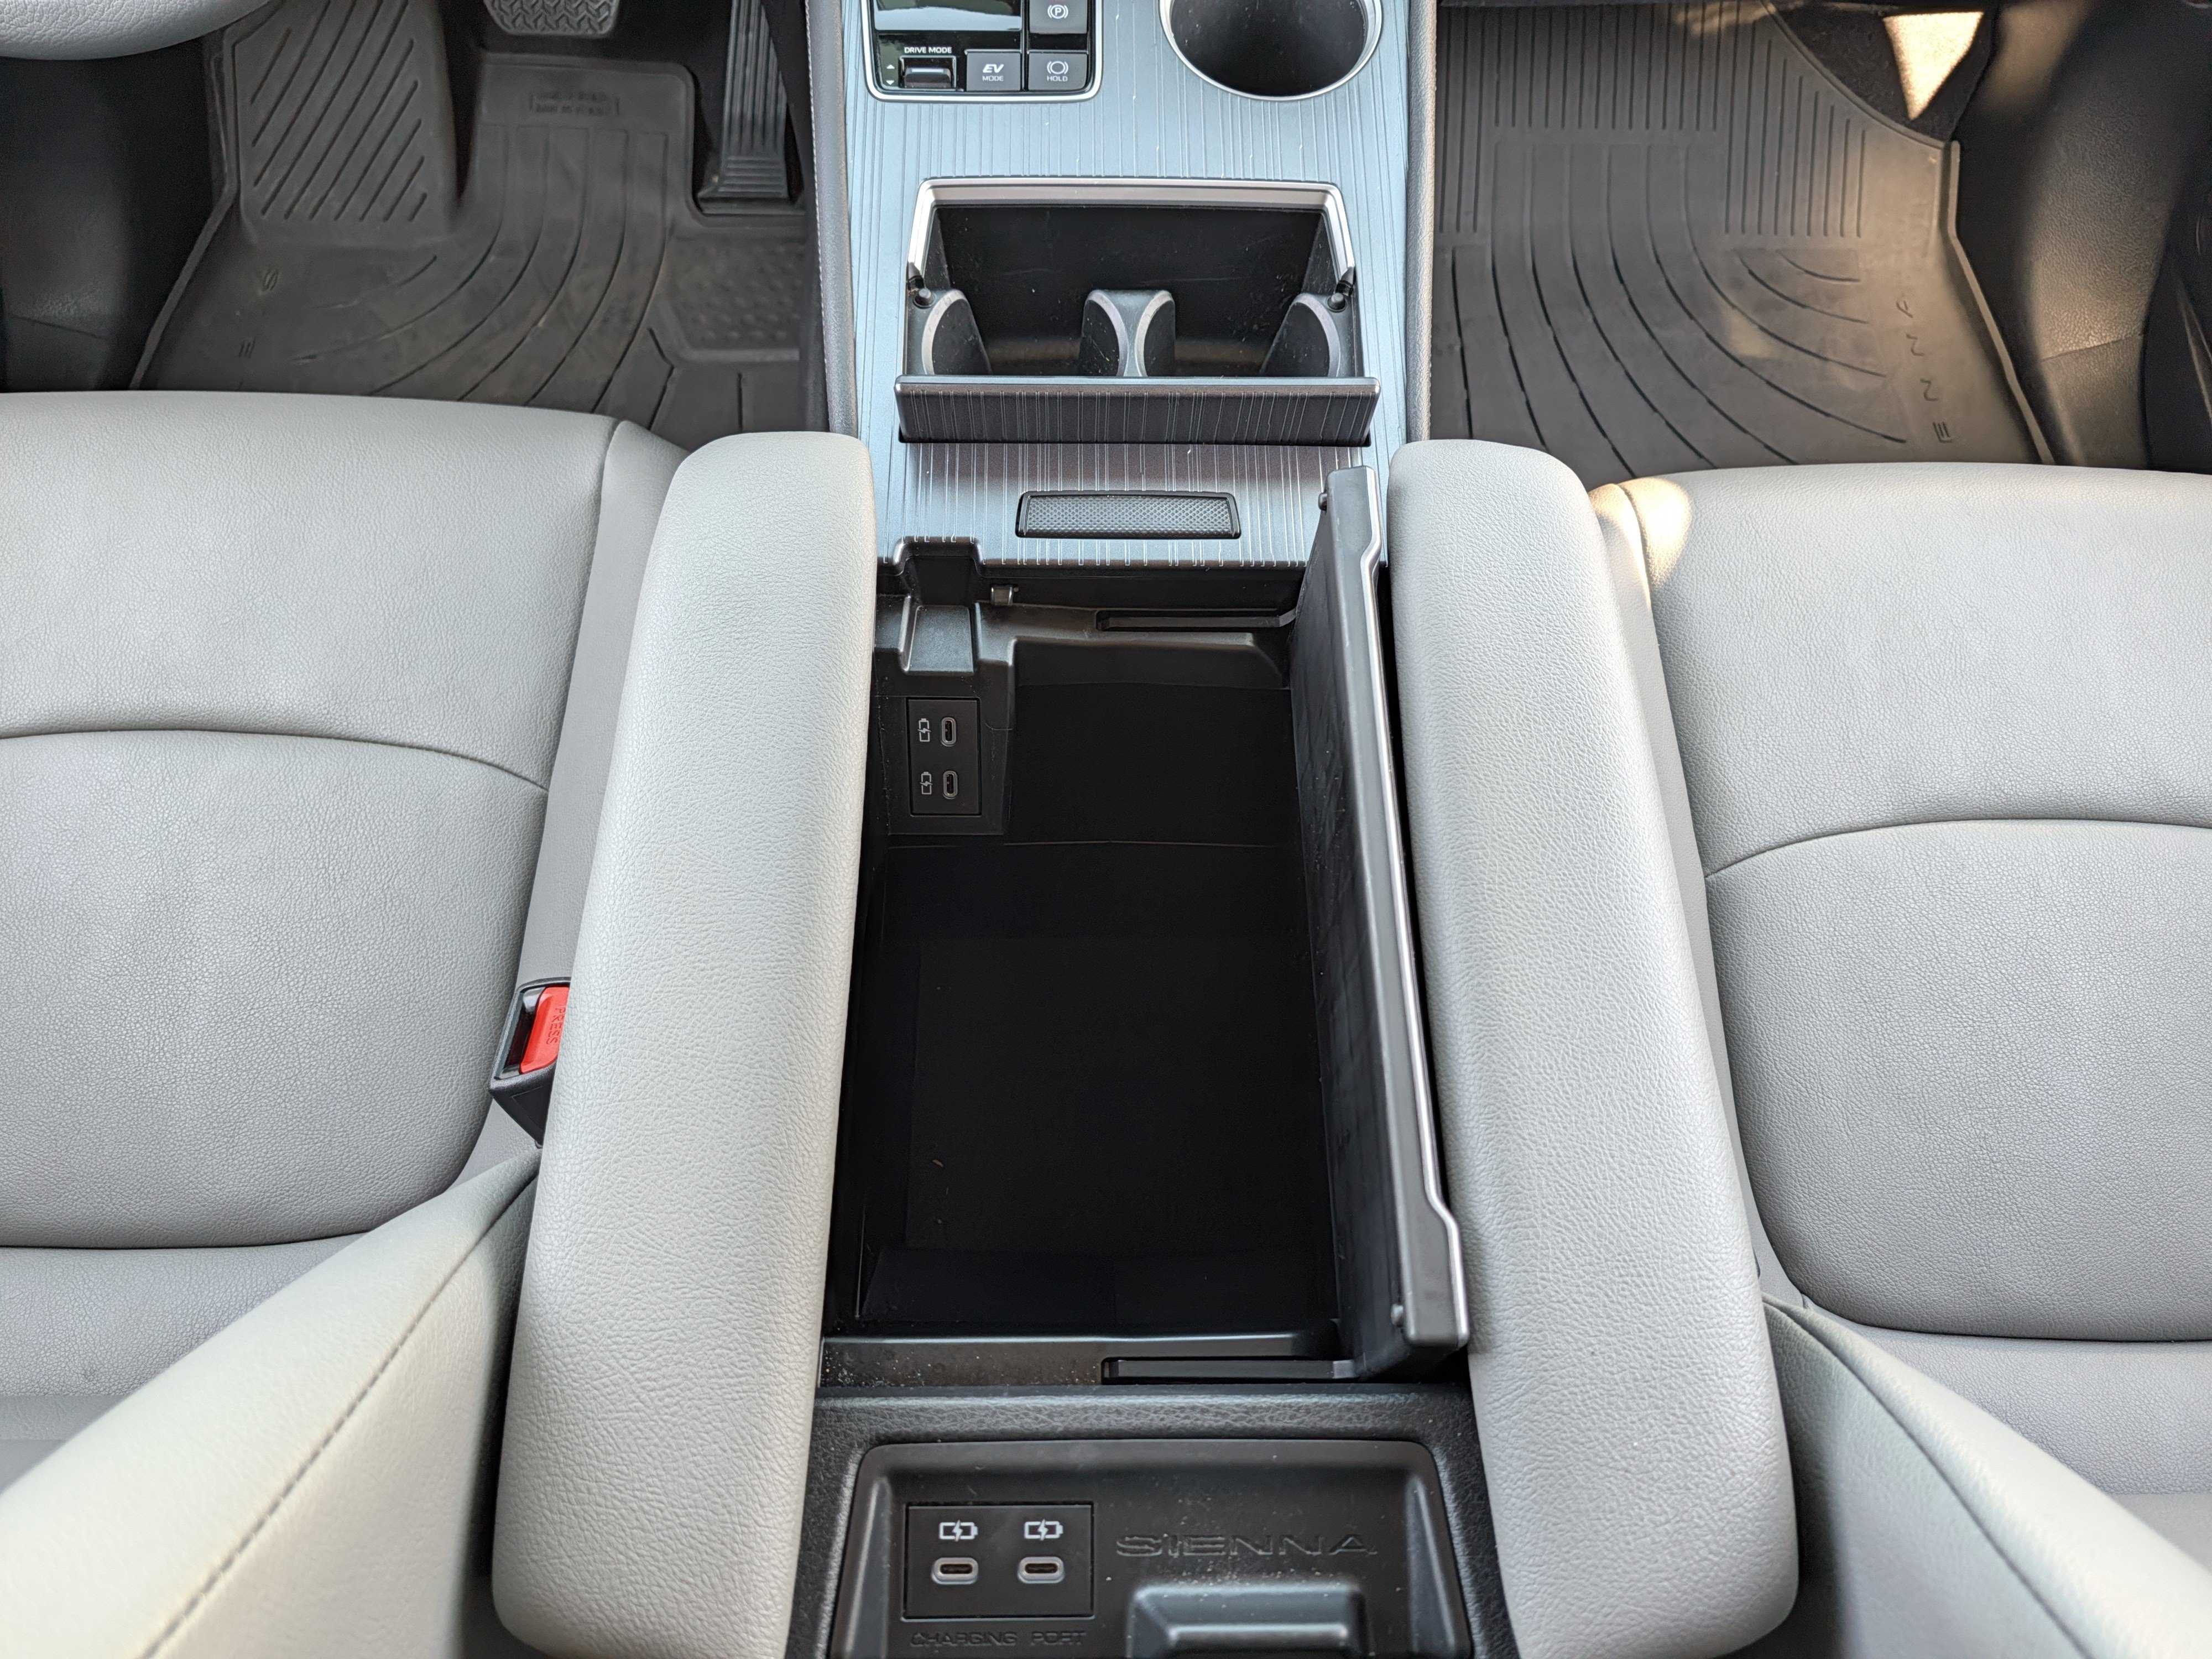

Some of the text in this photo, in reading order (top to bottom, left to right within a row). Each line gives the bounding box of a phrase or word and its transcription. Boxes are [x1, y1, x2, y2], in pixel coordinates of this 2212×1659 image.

[1055, 7, 1062, 16] P
[983, 64, 1004, 73] EV
[546, 1005, 566, 1045] PRESS
[1117, 1535, 1378, 1557] SIENNA
[910, 1630, 1087, 1647] CHARGING PORT
